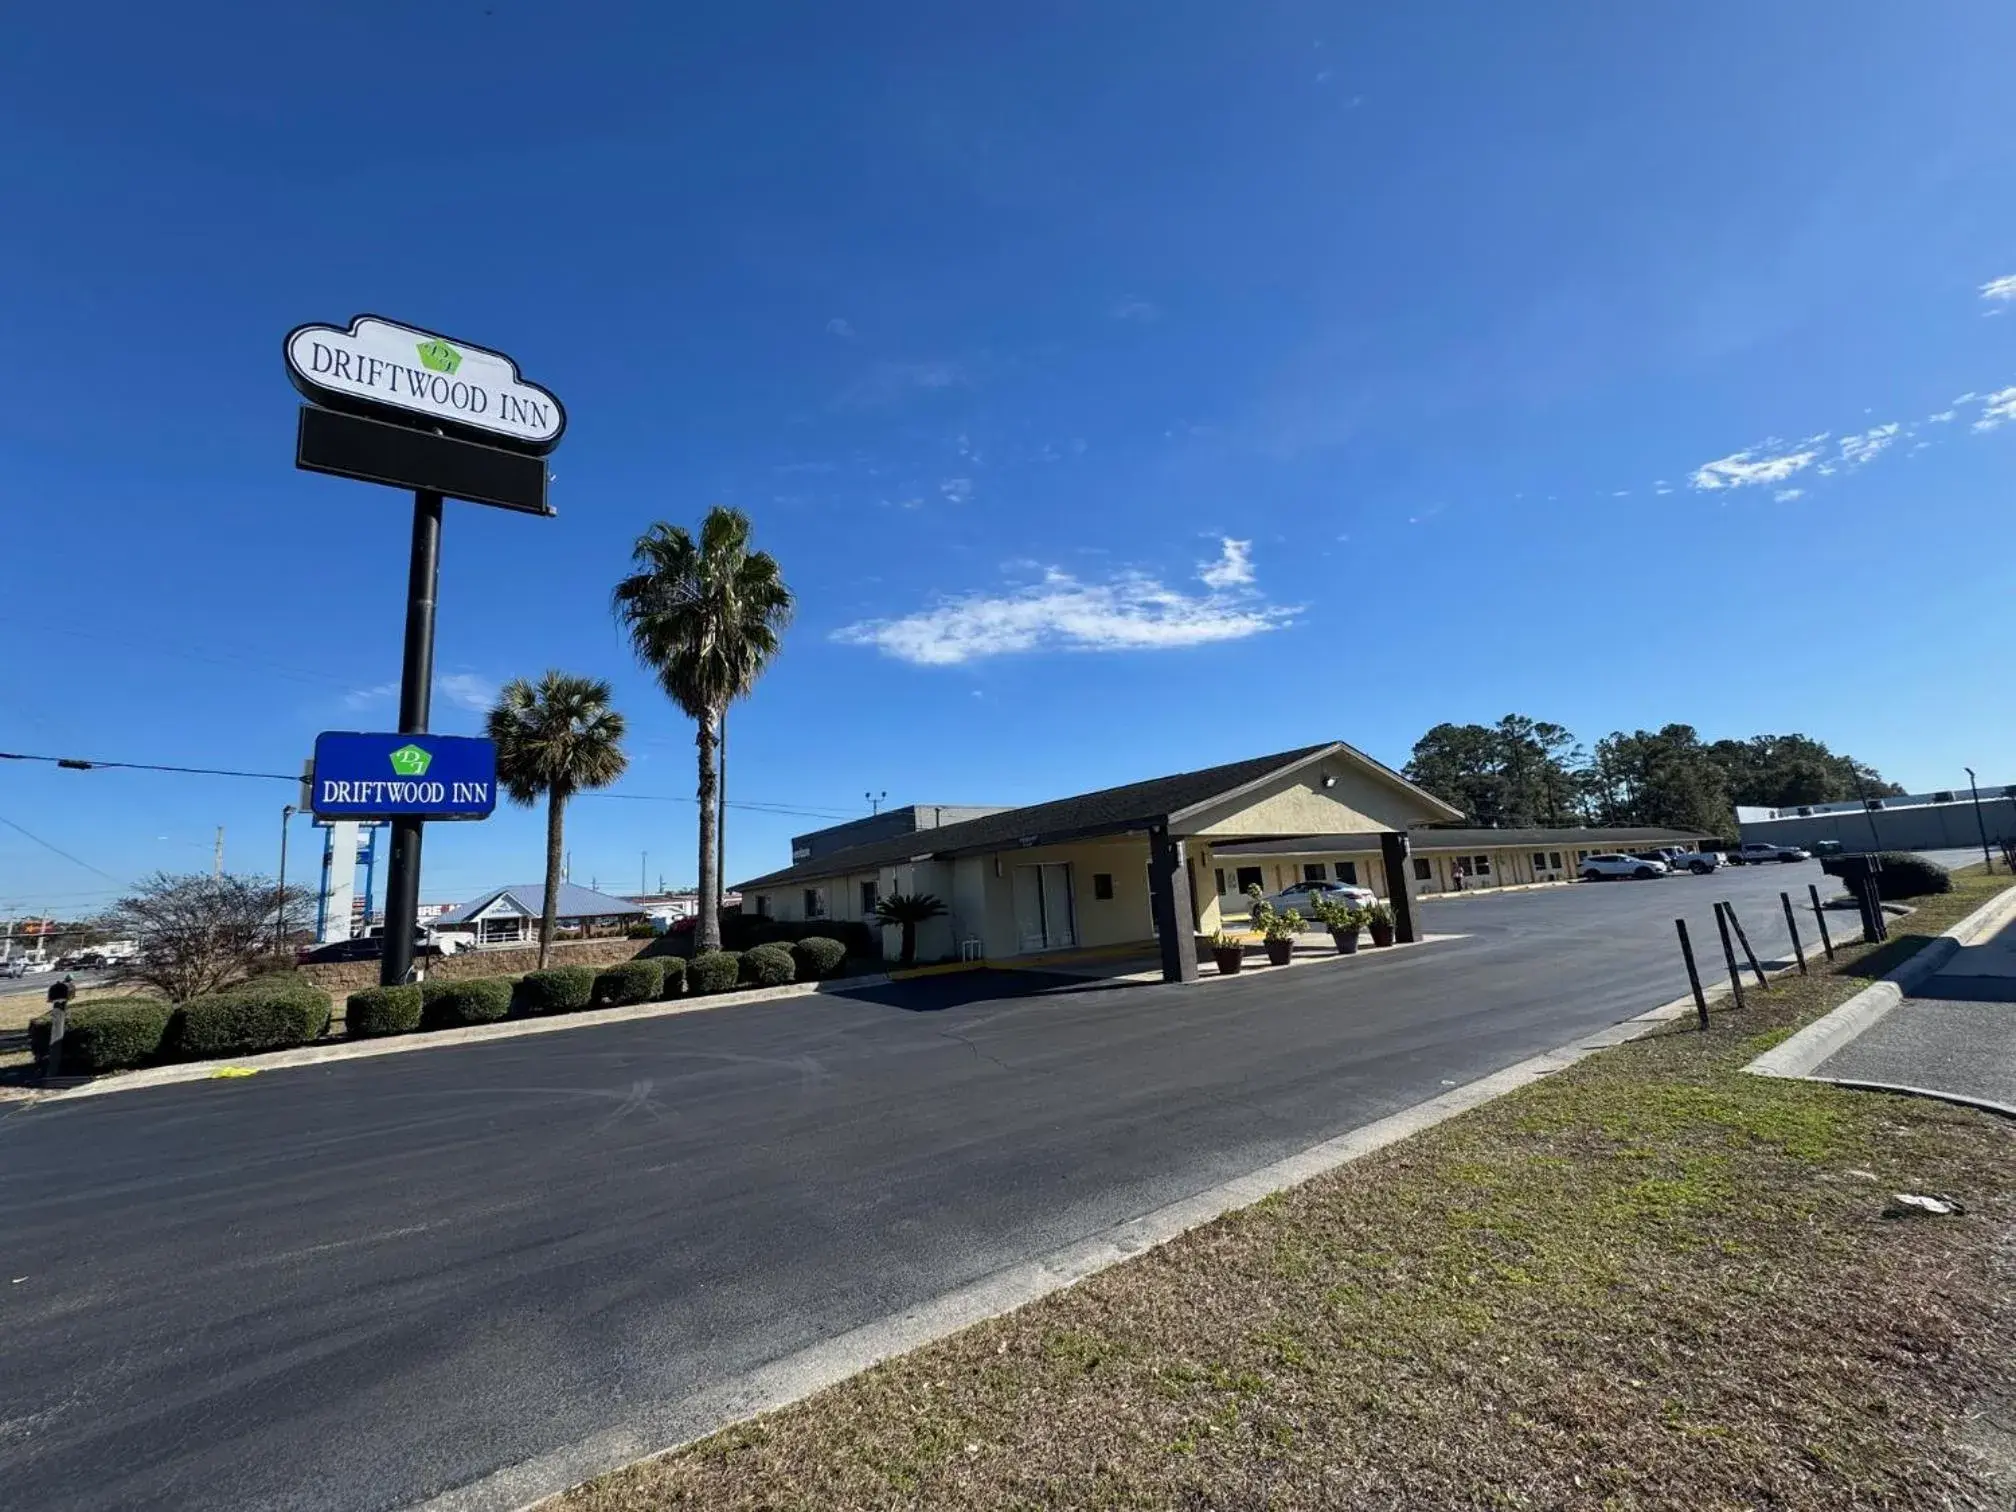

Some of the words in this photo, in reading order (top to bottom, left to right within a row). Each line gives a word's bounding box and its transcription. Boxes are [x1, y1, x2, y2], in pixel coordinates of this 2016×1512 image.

[311, 342, 488, 413] DRIFTWOOD
[499, 392, 549, 430] INN
[322, 780, 444, 803] DRIFTWOOD
[452, 783, 488, 803] INN
